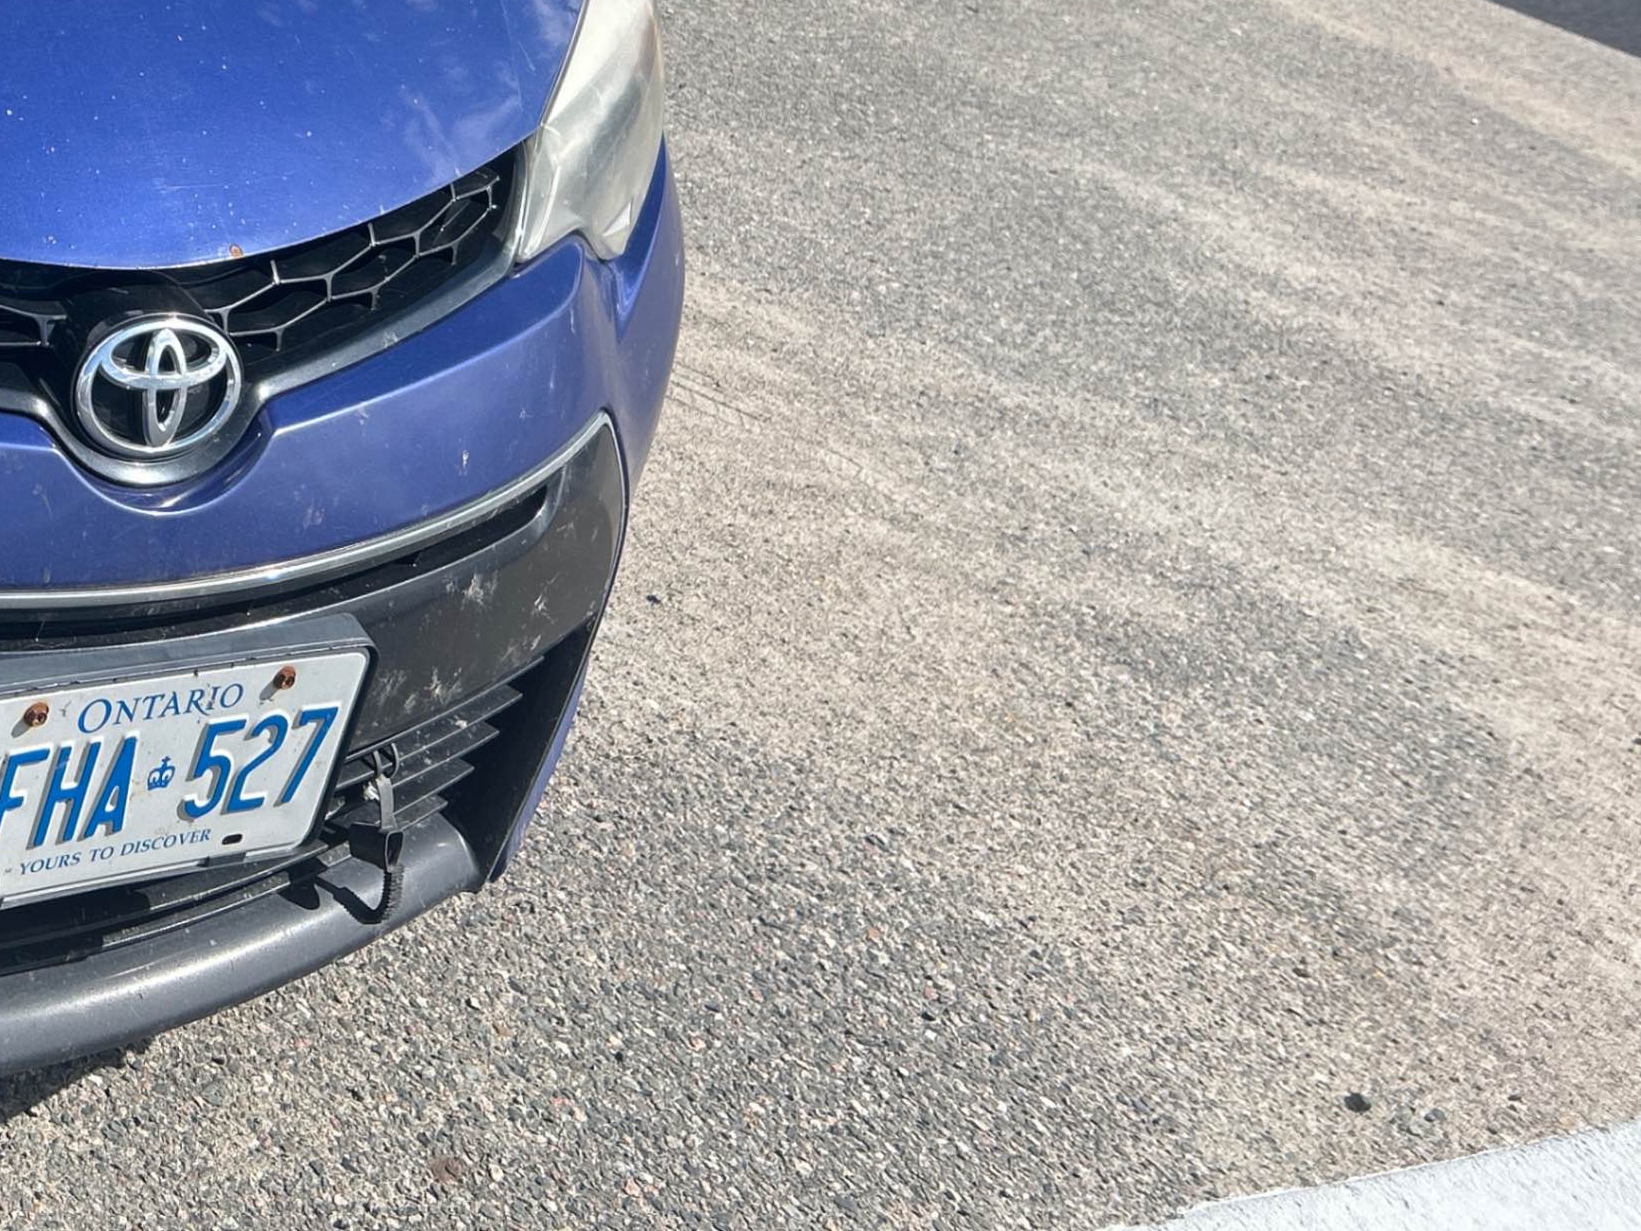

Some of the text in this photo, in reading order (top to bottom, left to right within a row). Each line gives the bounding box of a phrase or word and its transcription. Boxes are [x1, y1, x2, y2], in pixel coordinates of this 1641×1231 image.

[77, 682, 244, 734] ONTARIO
[181, 706, 340, 819] 527
[19, 828, 212, 875] YOURS TO DISCOVER
